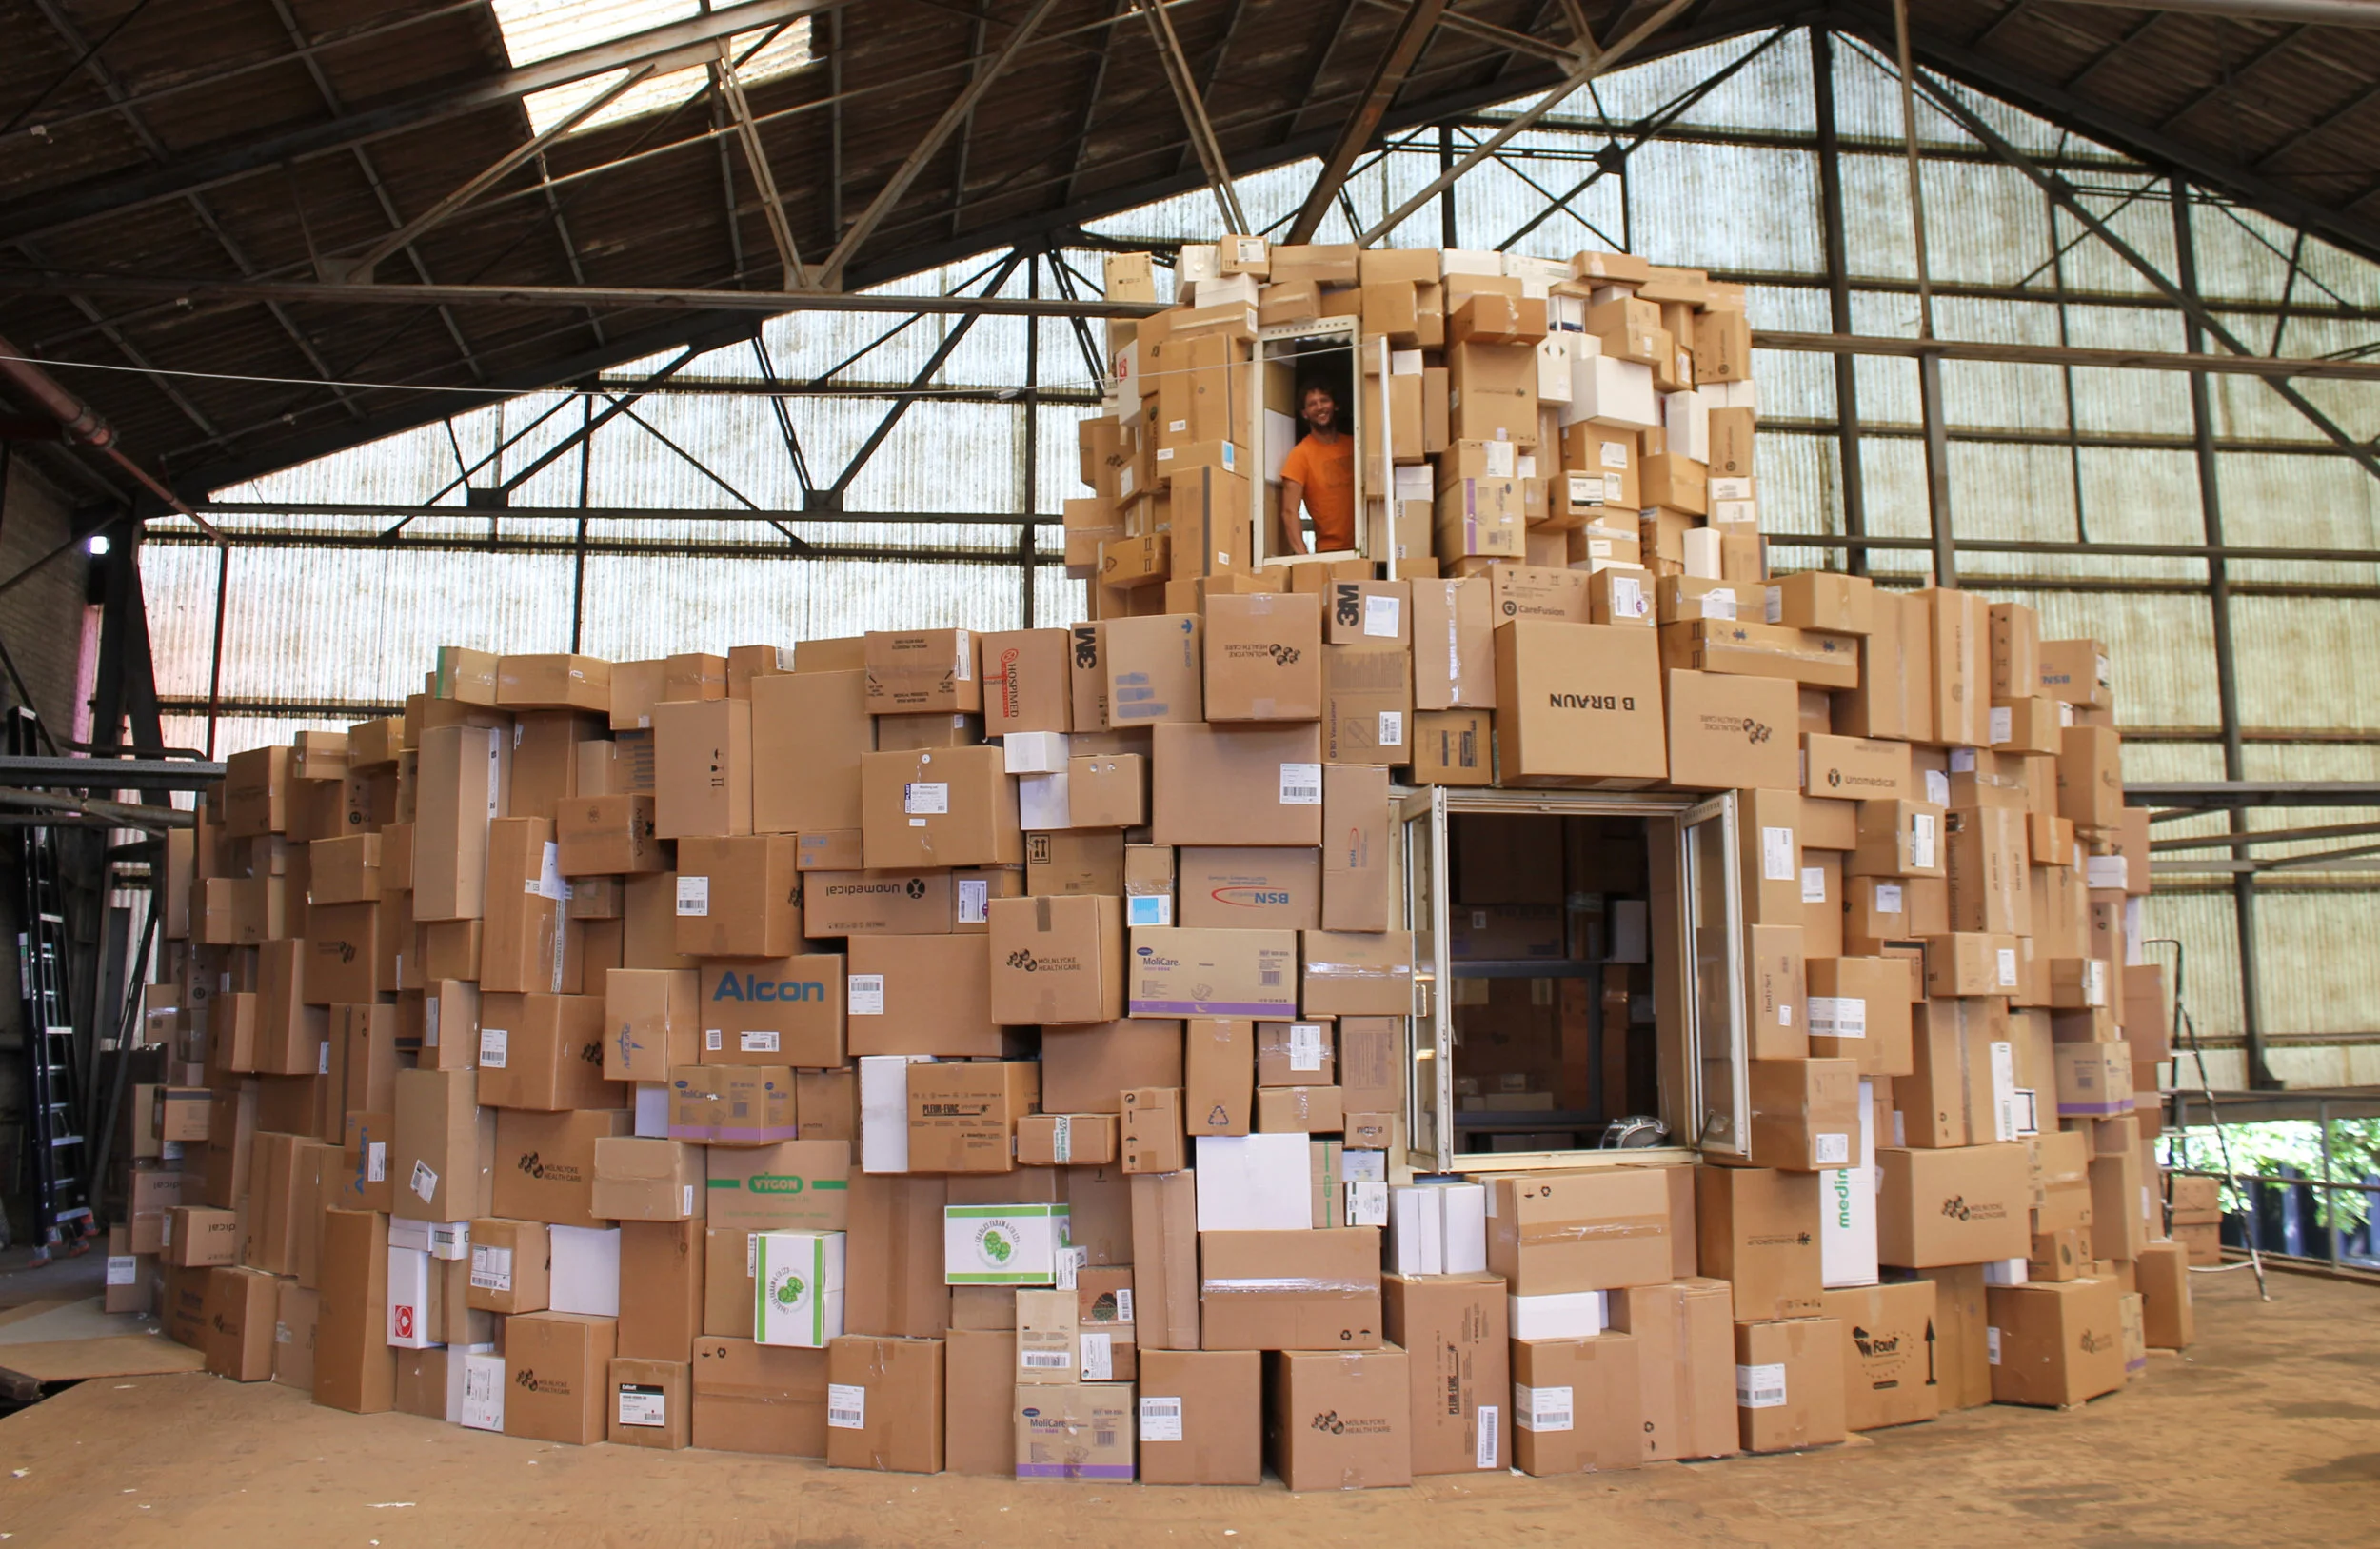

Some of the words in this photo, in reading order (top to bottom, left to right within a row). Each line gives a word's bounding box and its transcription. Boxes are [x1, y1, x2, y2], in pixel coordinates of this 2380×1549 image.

[1336, 584, 1359, 626] 3M
[1518, 605, 1565, 616] CareFusion
[1075, 627, 1097, 669] 3M
[2042, 675, 2070, 684] BSN
[1007, 663, 1019, 718] HOSPIMED
[1550, 693, 1616, 710] BRAUN
[1622, 697, 1635, 711] B
[1255, 893, 1289, 904] BSN
[712, 971, 825, 1002] Alcon
[922, 1104, 960, 1114] PLEUR-EVAC
[354, 1127, 368, 1195] Alcon
[544, 1172, 566, 1182] HEALTH
[753, 1178, 799, 1190] VYGON
[1030, 1419, 1066, 1428] MoliCare
